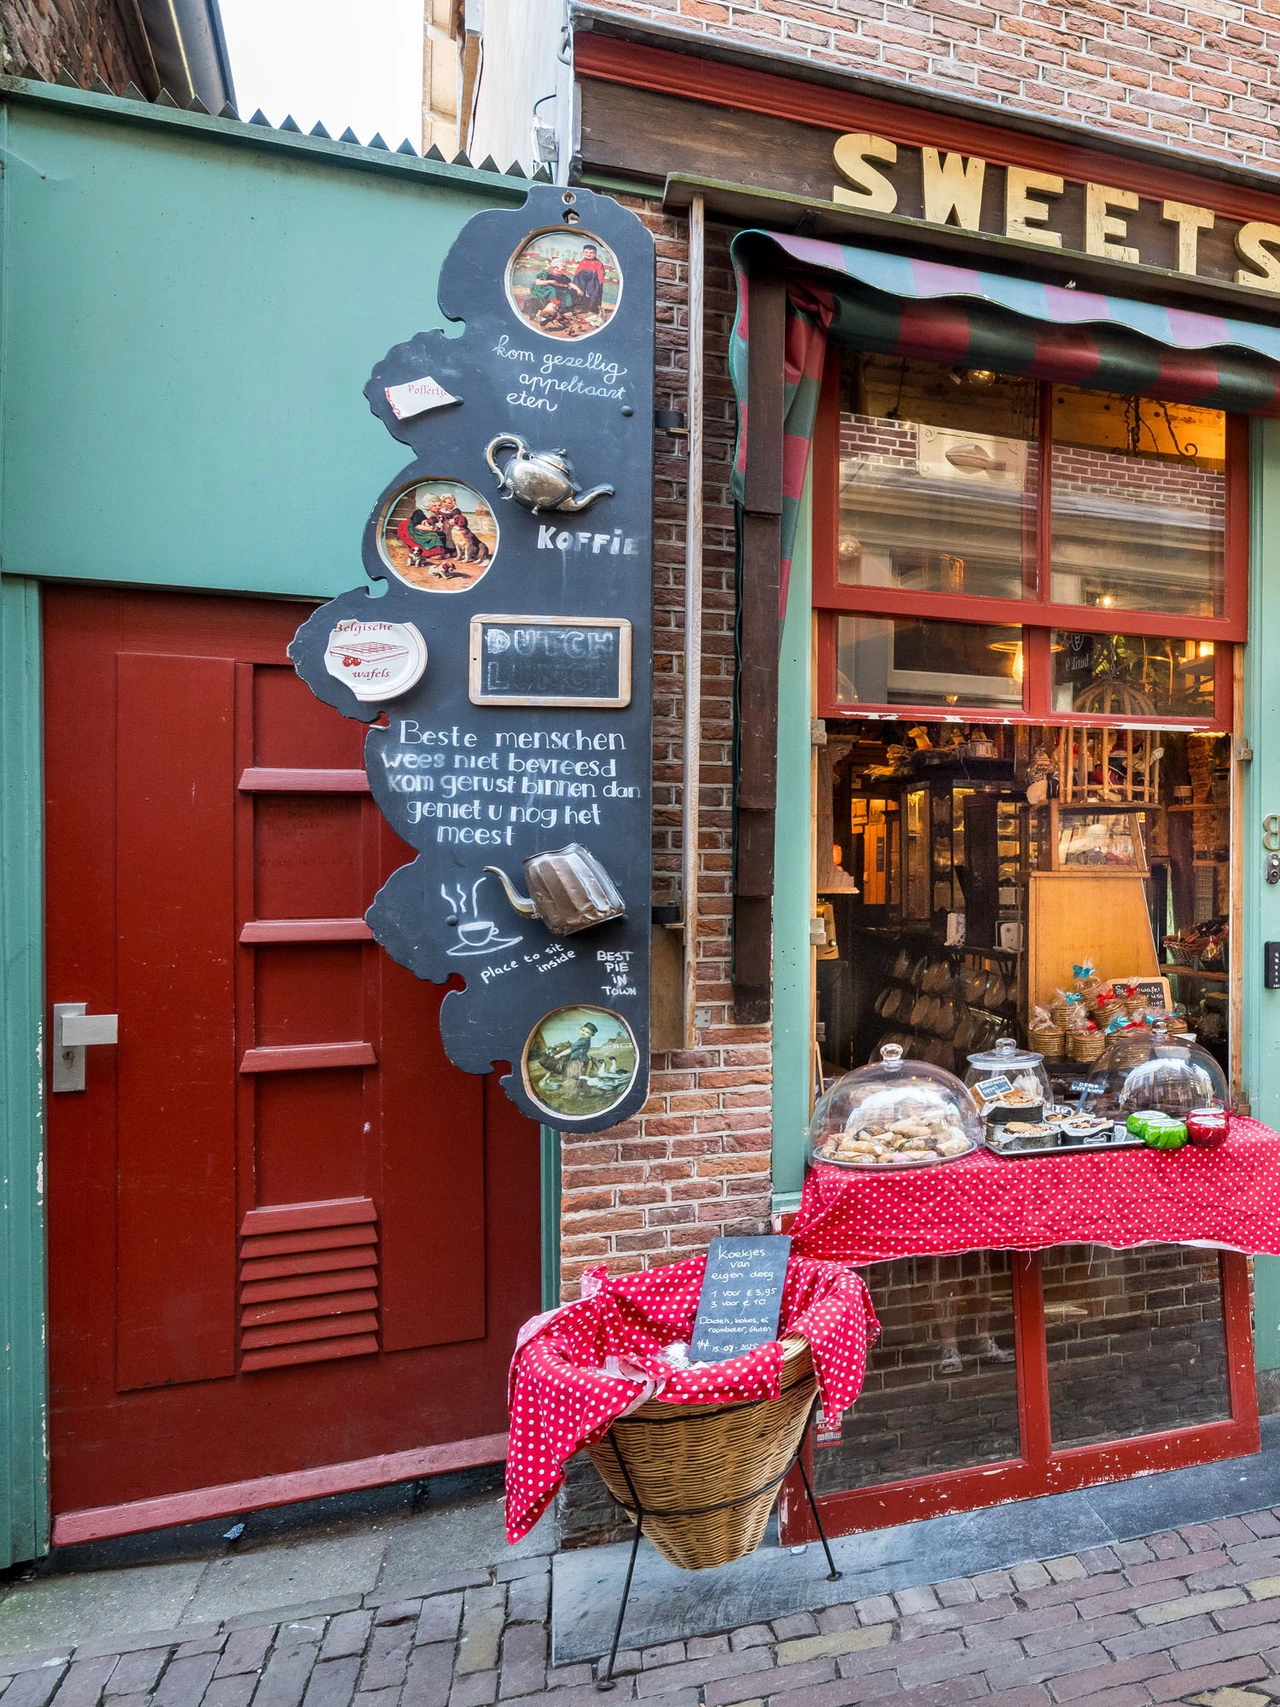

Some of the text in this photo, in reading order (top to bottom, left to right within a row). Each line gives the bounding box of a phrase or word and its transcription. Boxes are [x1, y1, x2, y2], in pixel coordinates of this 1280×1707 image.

[541, 350, 628, 379] gezellig
[519, 374, 628, 401] appeltaart
[507, 391, 558, 412] eten
[485, 628, 613, 659] DUTCH
[352, 667, 391, 680] wafels
[400, 720, 627, 751] Beste menschen
[381, 752, 617, 778] wees niet bevreesd
[441, 775, 517, 798] gerust
[522, 777, 597, 798] binnen
[603, 781, 642, 798] dan
[406, 800, 602, 828] geniet u nog het
[438, 825, 515, 846] meest
[523, 953, 540, 966] to
[545, 942, 565, 956] sit
[538, 950, 577, 973] inside
[597, 951, 634, 962] BEST
[601, 986, 637, 996] TOWN
[730, 1261, 750, 1269] van
[711, 1271, 774, 1283] eigen deeg
